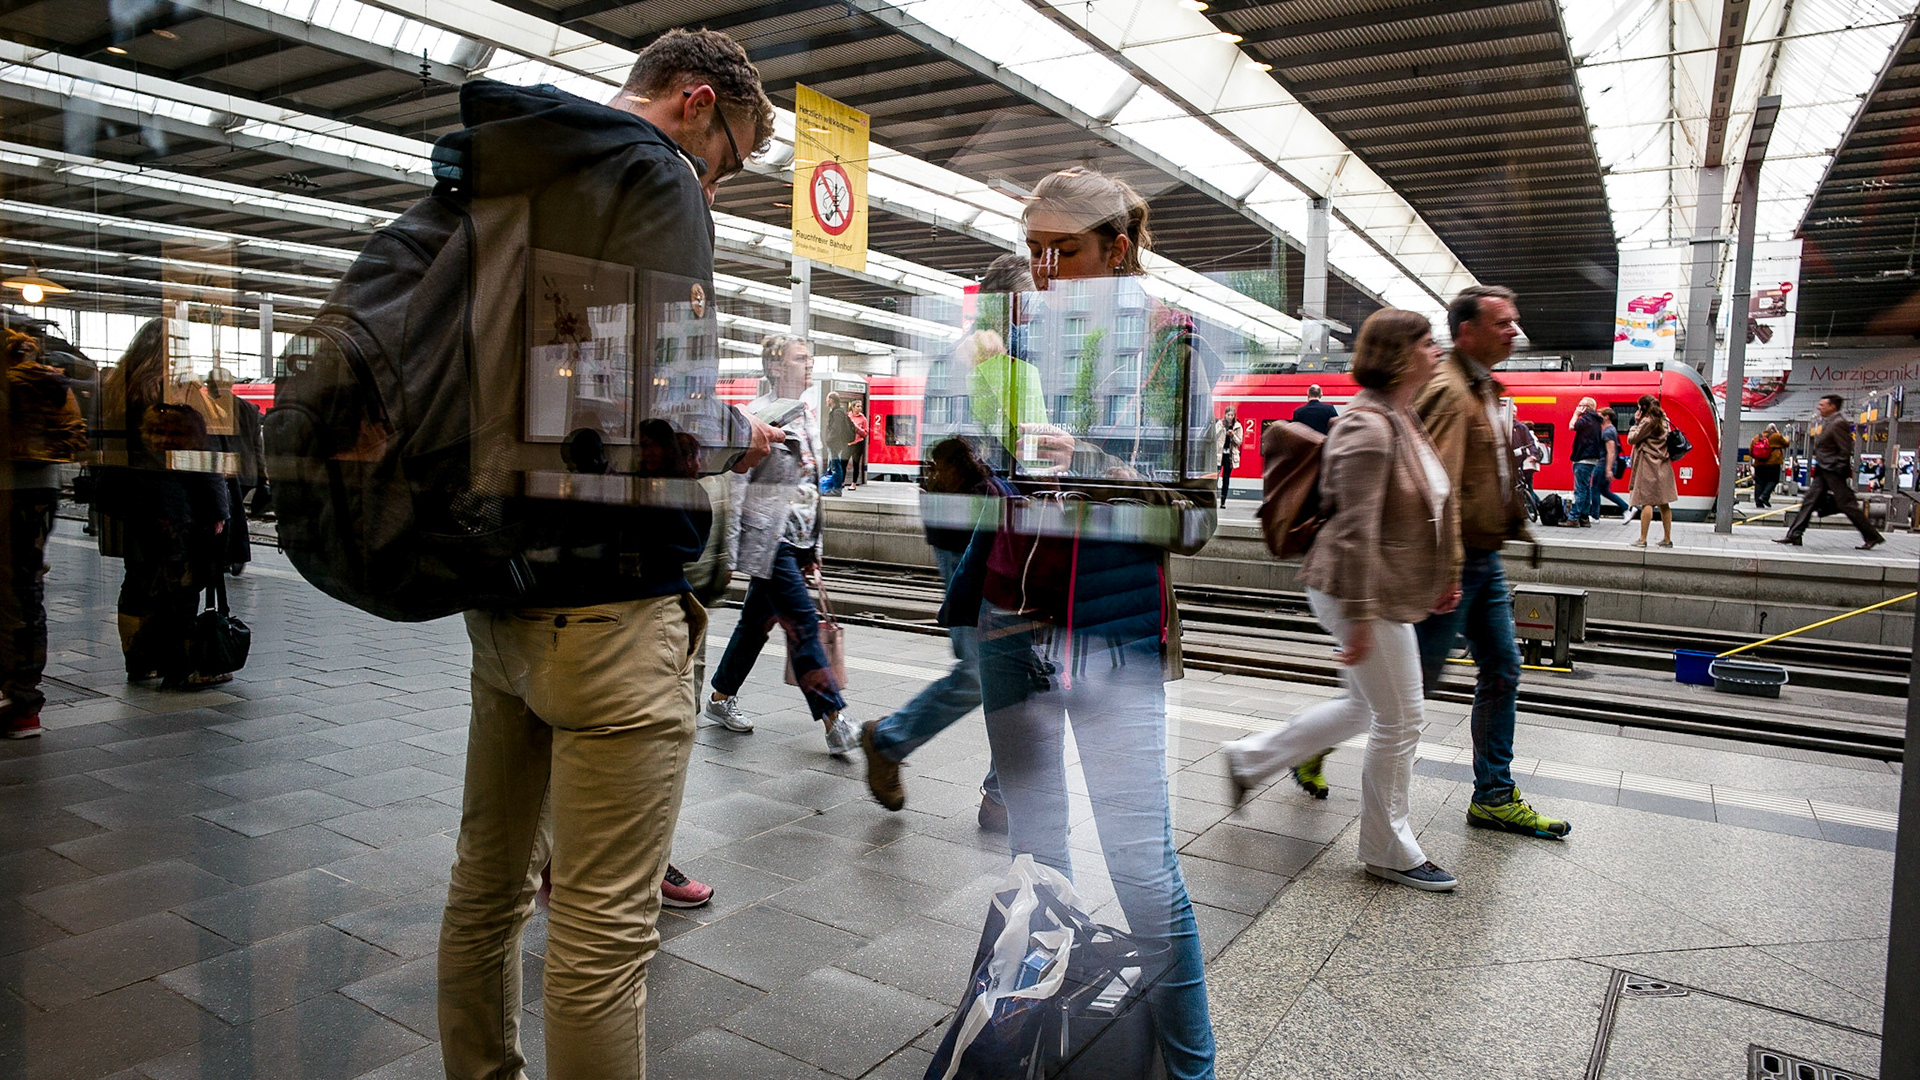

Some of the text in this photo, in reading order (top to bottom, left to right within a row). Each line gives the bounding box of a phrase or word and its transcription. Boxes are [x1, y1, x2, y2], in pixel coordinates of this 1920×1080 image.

[799, 104, 822, 121] Herzlich
[823, 116, 855, 134] willkommen
[795, 229, 853, 252] Rauchfreier Bahnhof
[1810, 363, 1919, 386] Marzipanik!
[874, 414, 882, 426] 2
[1246, 419, 1255, 432] 2
